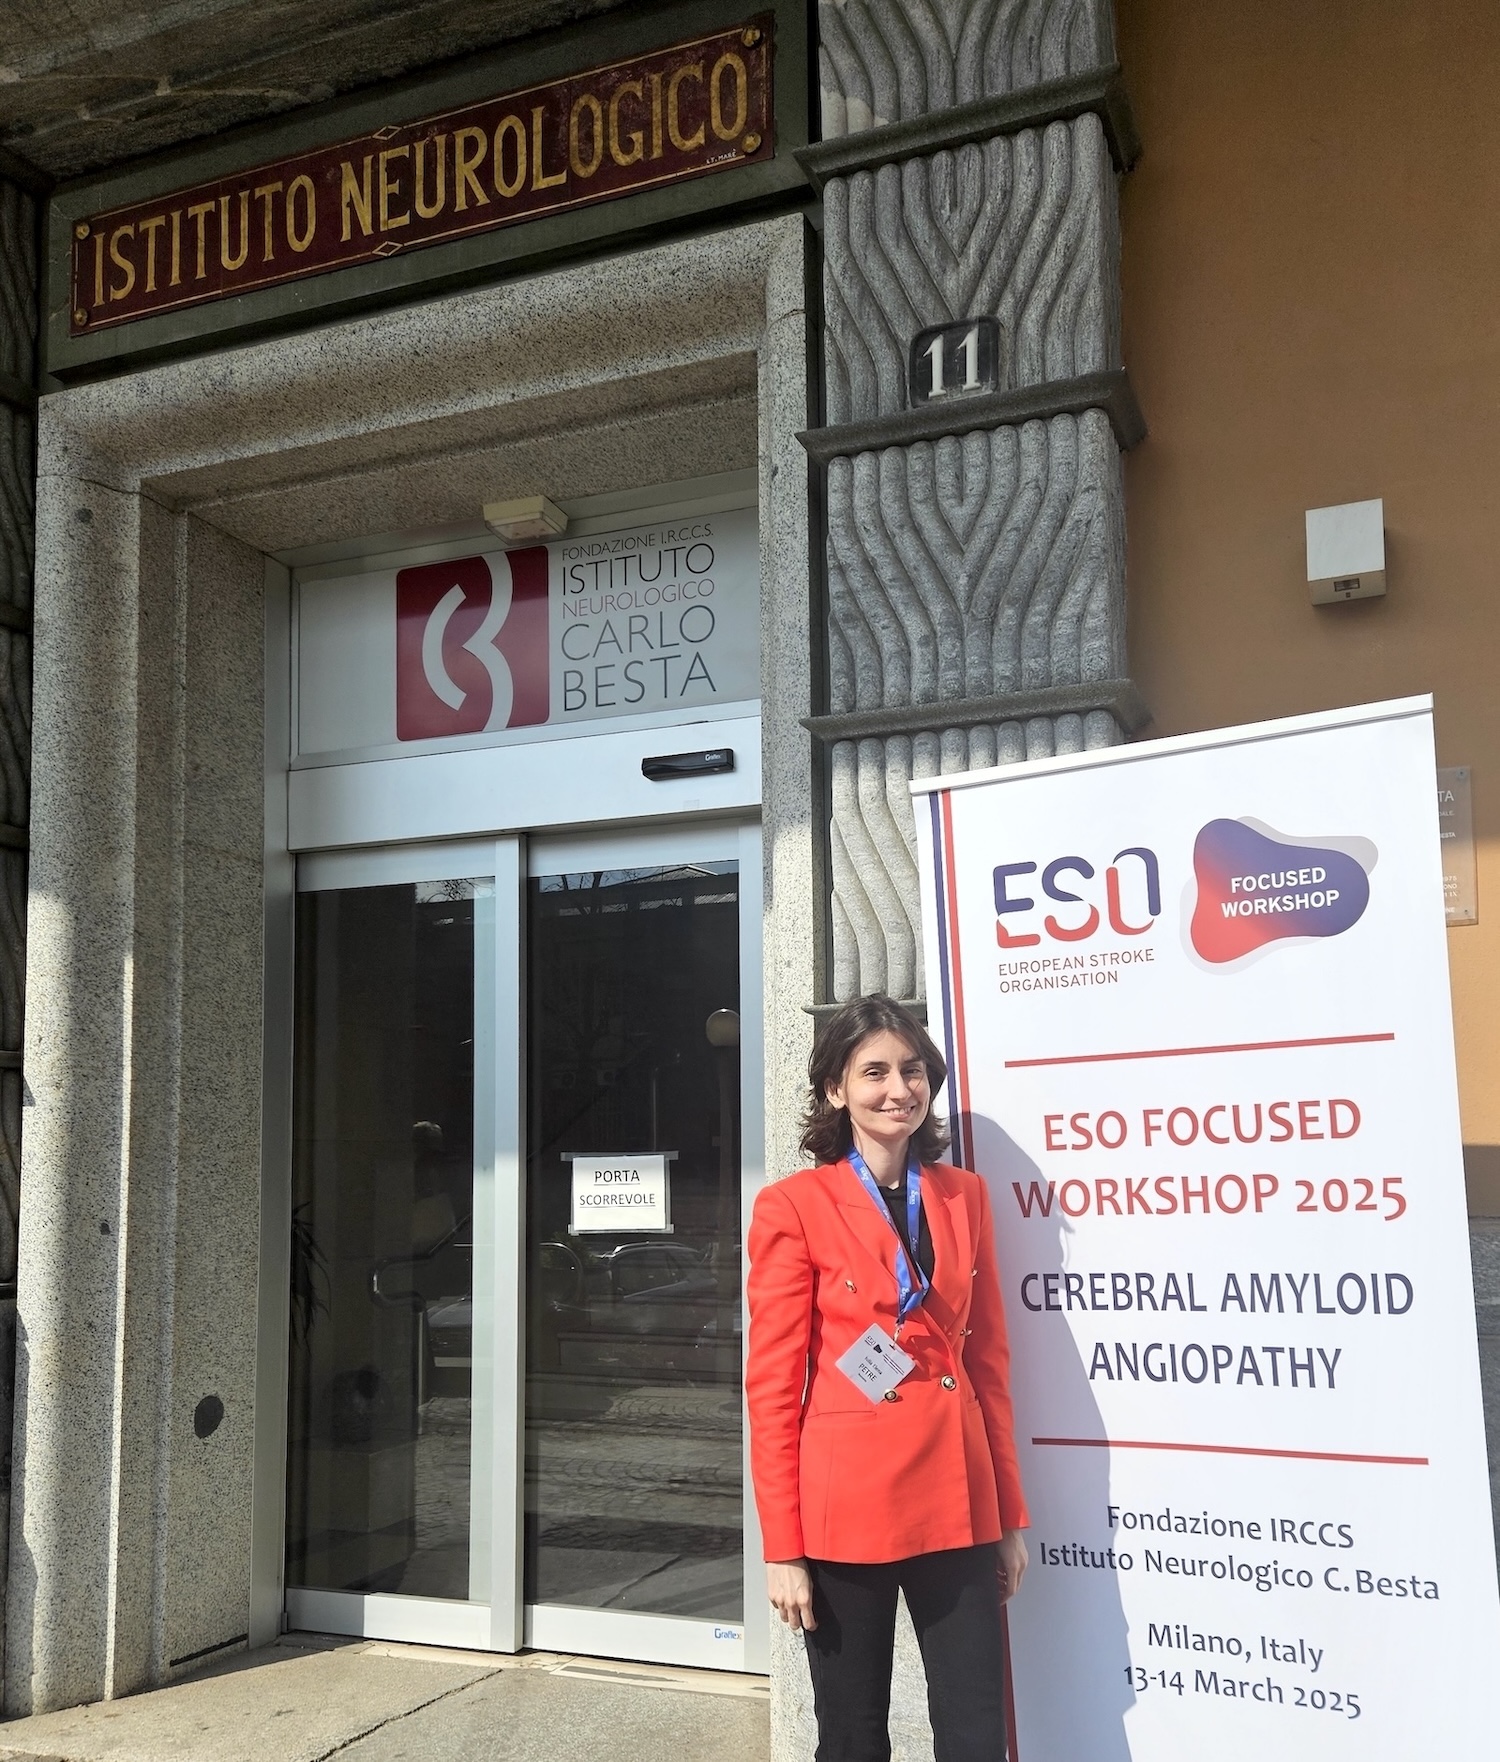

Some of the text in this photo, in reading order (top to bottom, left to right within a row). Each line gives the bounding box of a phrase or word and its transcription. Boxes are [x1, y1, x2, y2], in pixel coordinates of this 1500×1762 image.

[92, 51, 748, 307] ISTITUTO NEUROLOGICO
[922, 325, 981, 400] 11
[561, 523, 714, 561] FONDAZIONE I.R.C.C.S.
[562, 543, 715, 596] ISTITUTO
[562, 578, 715, 619] NEUROLOGICO
[561, 604, 715, 661] CARLO
[563, 651, 717, 712] BESTA
[992, 847, 1161, 949] ESO
[1220, 889, 1341, 919] WORKSHOP
[1230, 866, 1327, 894] FOCUSED
[998, 948, 1155, 977] EUROPEAN STROKE
[999, 970, 1119, 994] ORGANISATION
[1044, 1098, 1362, 1152] ESO FOCUSED
[579, 1193, 656, 1206] SCORREVOLE
[594, 1170, 641, 1183] PORTA
[1012, 1172, 1408, 1222] WORKSHOP 2025
[1020, 1272, 1414, 1315] CEREBRAL AMYLOID
[858, 1363, 877, 1382] PETRE
[1088, 1341, 1343, 1390] ANGIOPATHY
[1106, 1505, 1354, 1549] Fondazione IRCCS
[1040, 1542, 1134, 1572] Istituto
[1144, 1549, 1313, 1593] Neurologico
[1148, 1623, 1324, 1672] Milano, Italy
[1123, 1666, 1361, 1720] 13-14 March 2025
